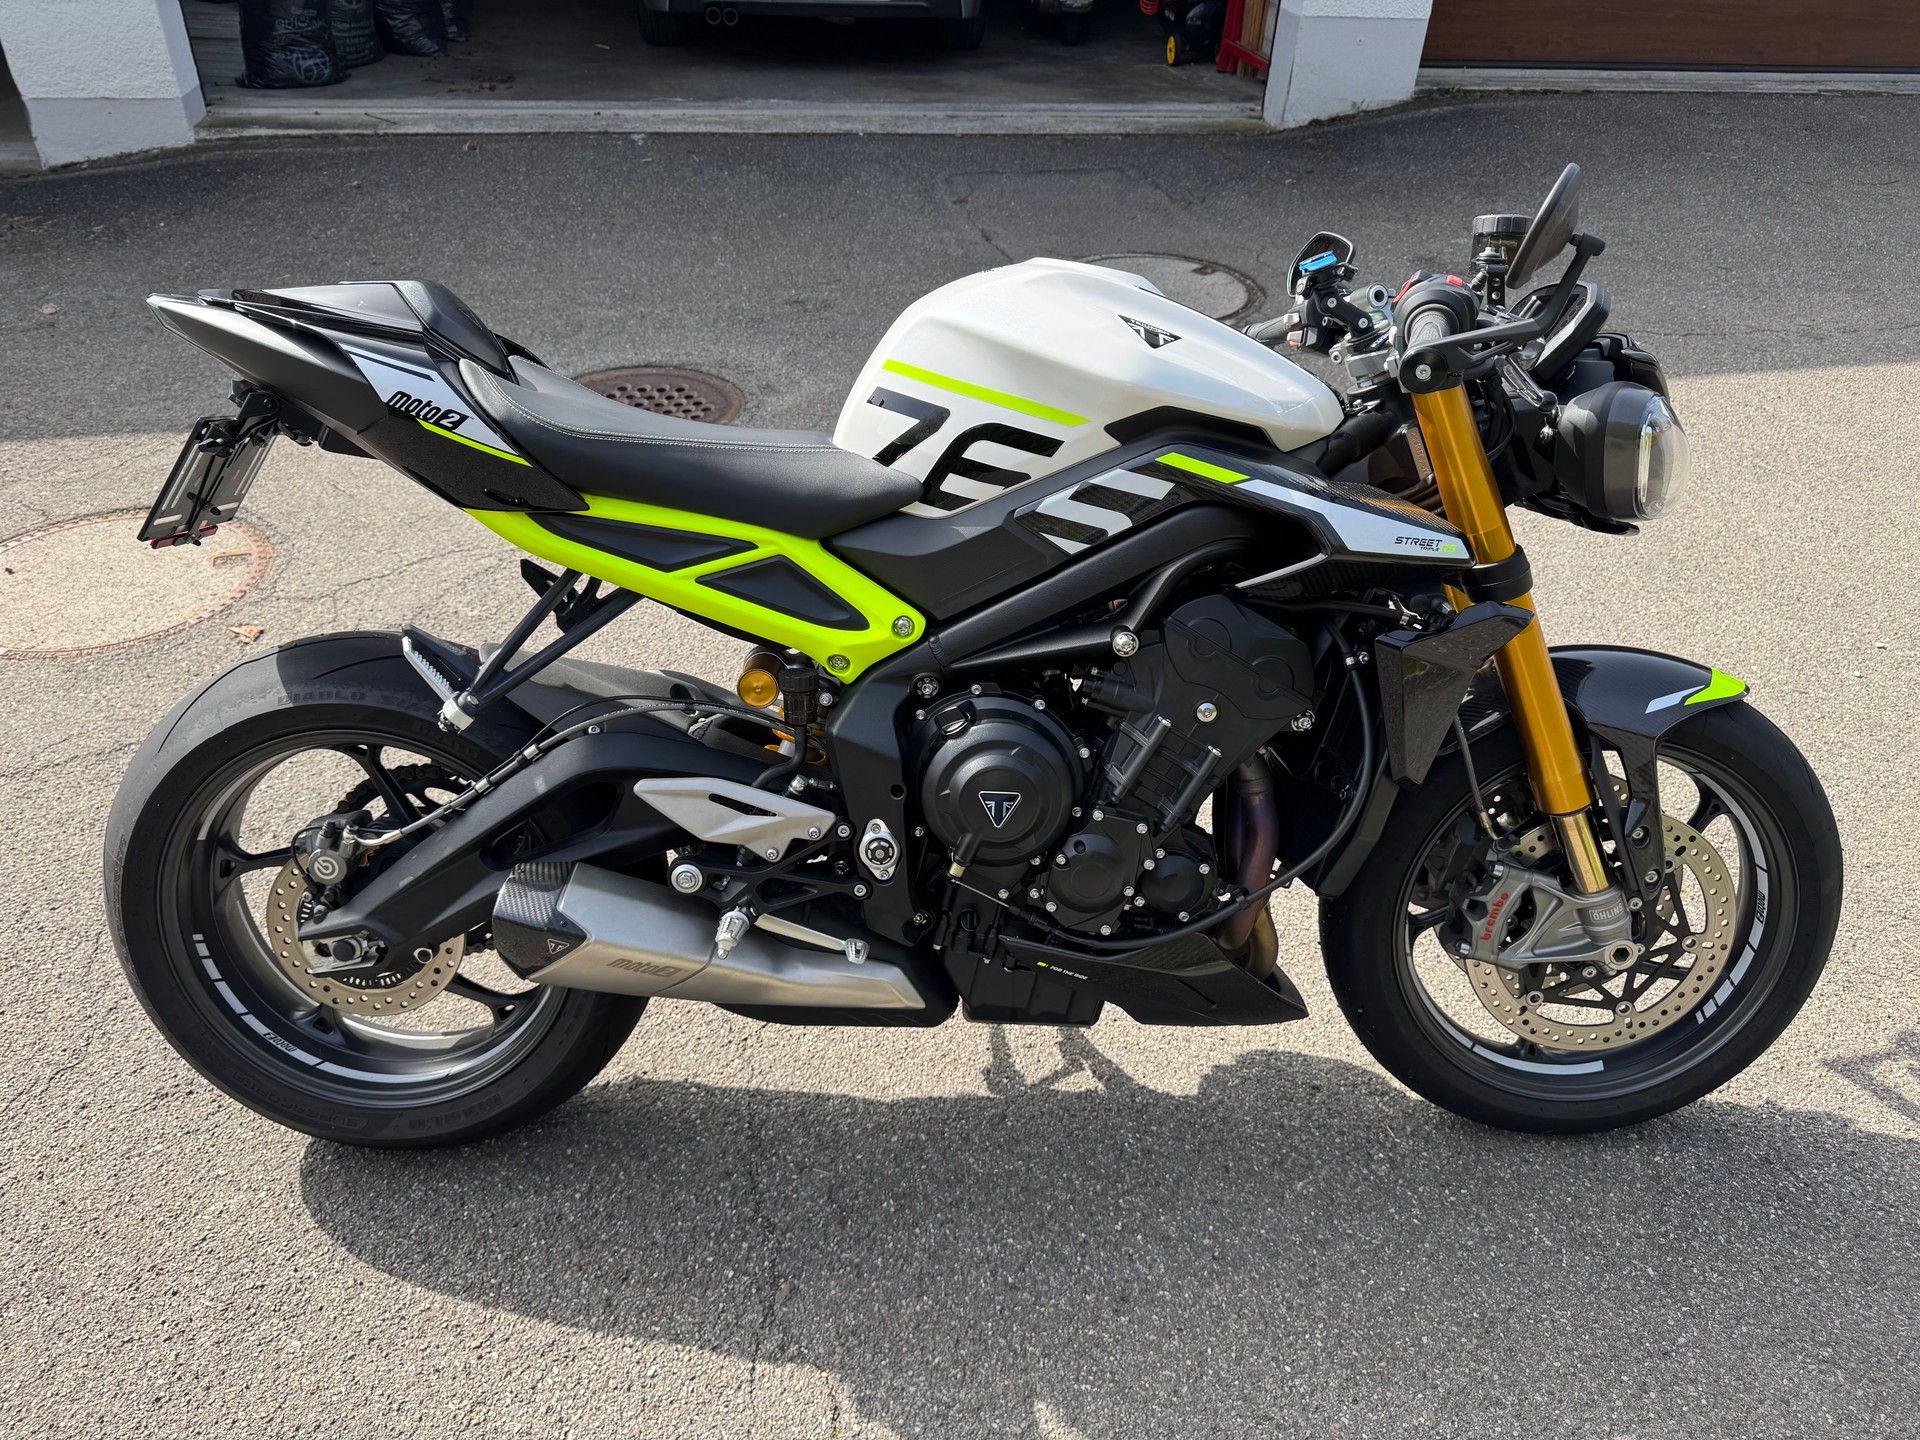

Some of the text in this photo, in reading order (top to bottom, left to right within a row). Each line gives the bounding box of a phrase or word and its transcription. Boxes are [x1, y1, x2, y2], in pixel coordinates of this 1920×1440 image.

[385, 390, 469, 431] moto2
[1394, 536, 1443, 548] STREET
[1479, 892, 1510, 942] brembo
[1592, 902, 1625, 922] ÖHLINS
[605, 957, 683, 978] moto2
[1049, 965, 1089, 981] FOR THE RIDE
